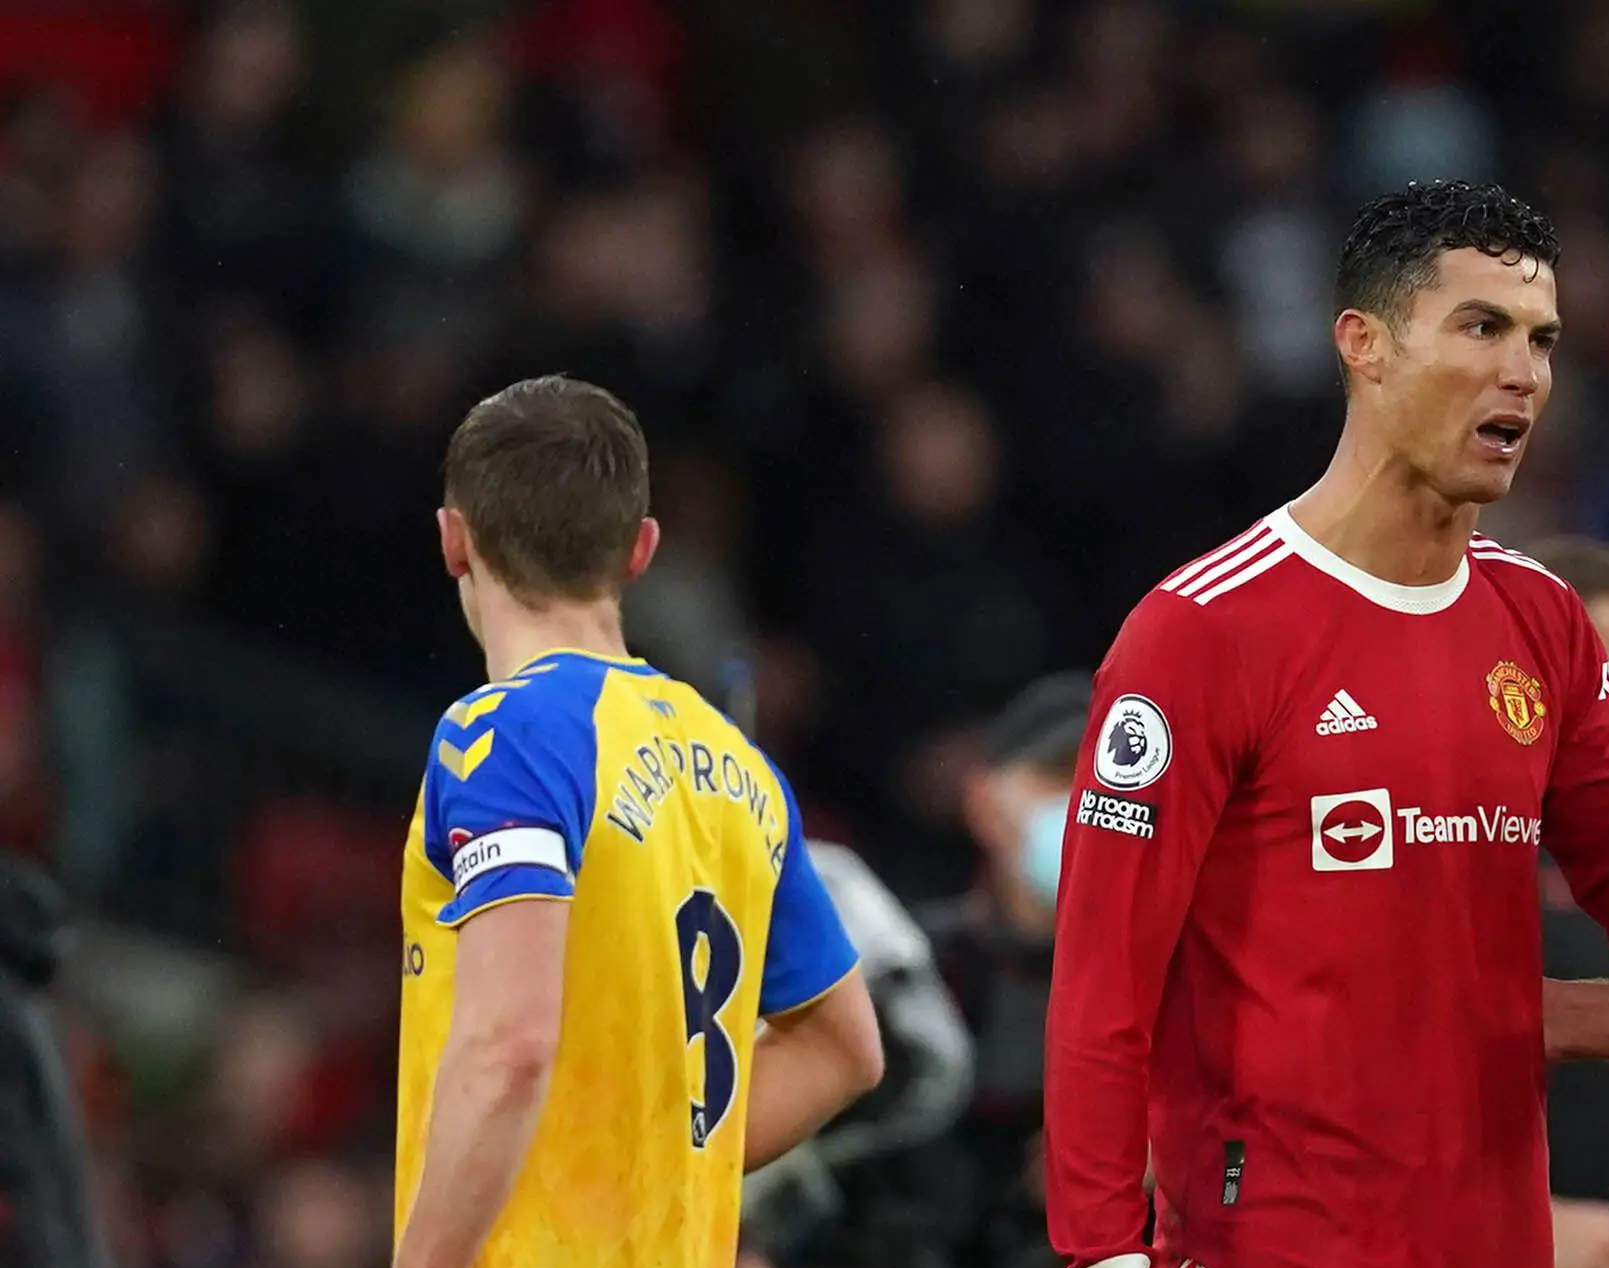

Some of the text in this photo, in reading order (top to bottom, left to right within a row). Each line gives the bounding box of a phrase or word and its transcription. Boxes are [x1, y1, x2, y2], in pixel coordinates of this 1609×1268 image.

[1316, 714, 1378, 736] adidas
[1081, 789, 1150, 822] No room
[455, 841, 501, 885] ptain
[674, 888, 743, 1149] 8
